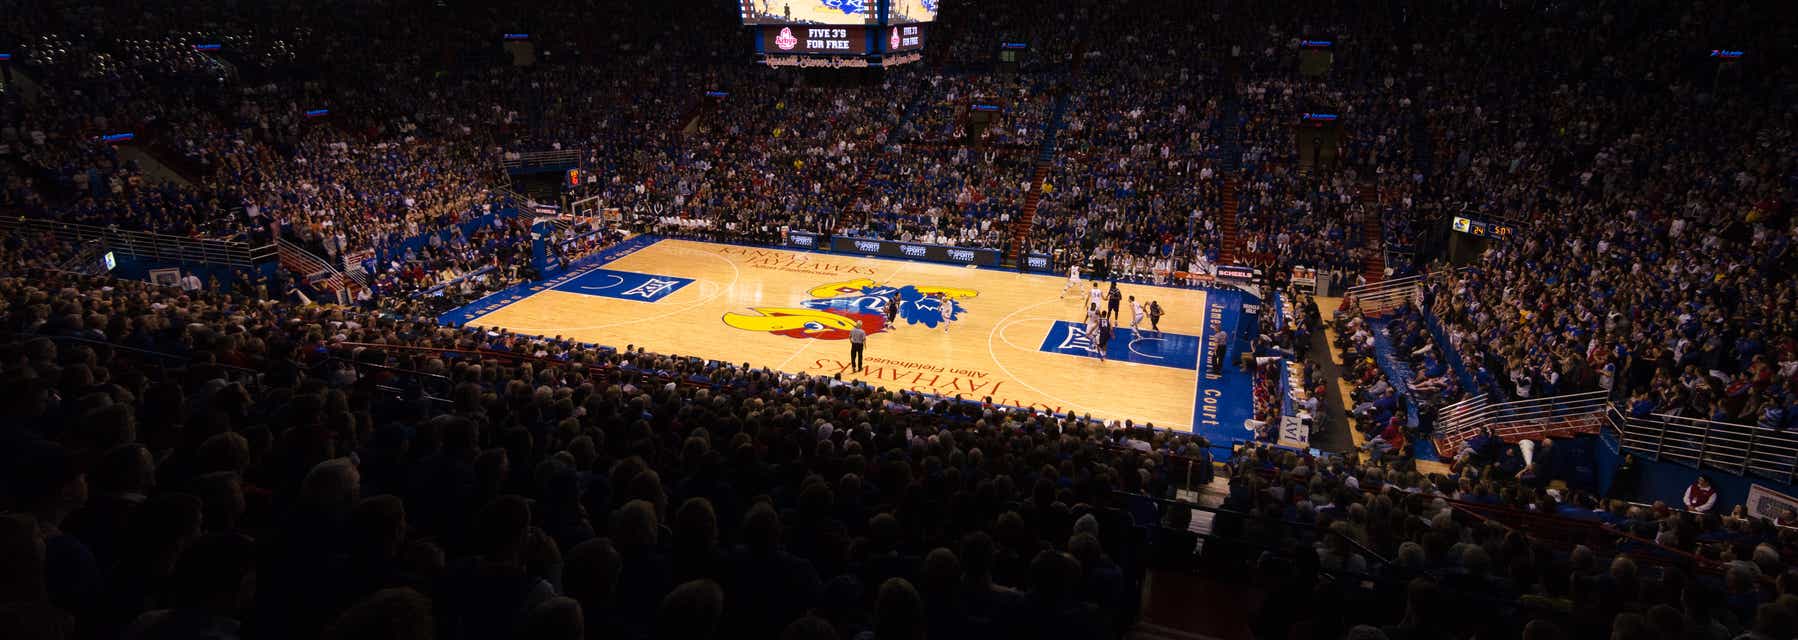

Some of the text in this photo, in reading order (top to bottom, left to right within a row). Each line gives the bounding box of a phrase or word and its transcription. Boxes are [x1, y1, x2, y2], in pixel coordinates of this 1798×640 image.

[808, 28, 847, 38] FIVE 3'S
[806, 39, 849, 49] FOR FREE
[1218, 270, 1252, 278] SCHEELS
[864, 356, 989, 379] Allen Fieldhouse
[808, 358, 1006, 397] JAYHAWKS
[1201, 388, 1222, 426] Court
